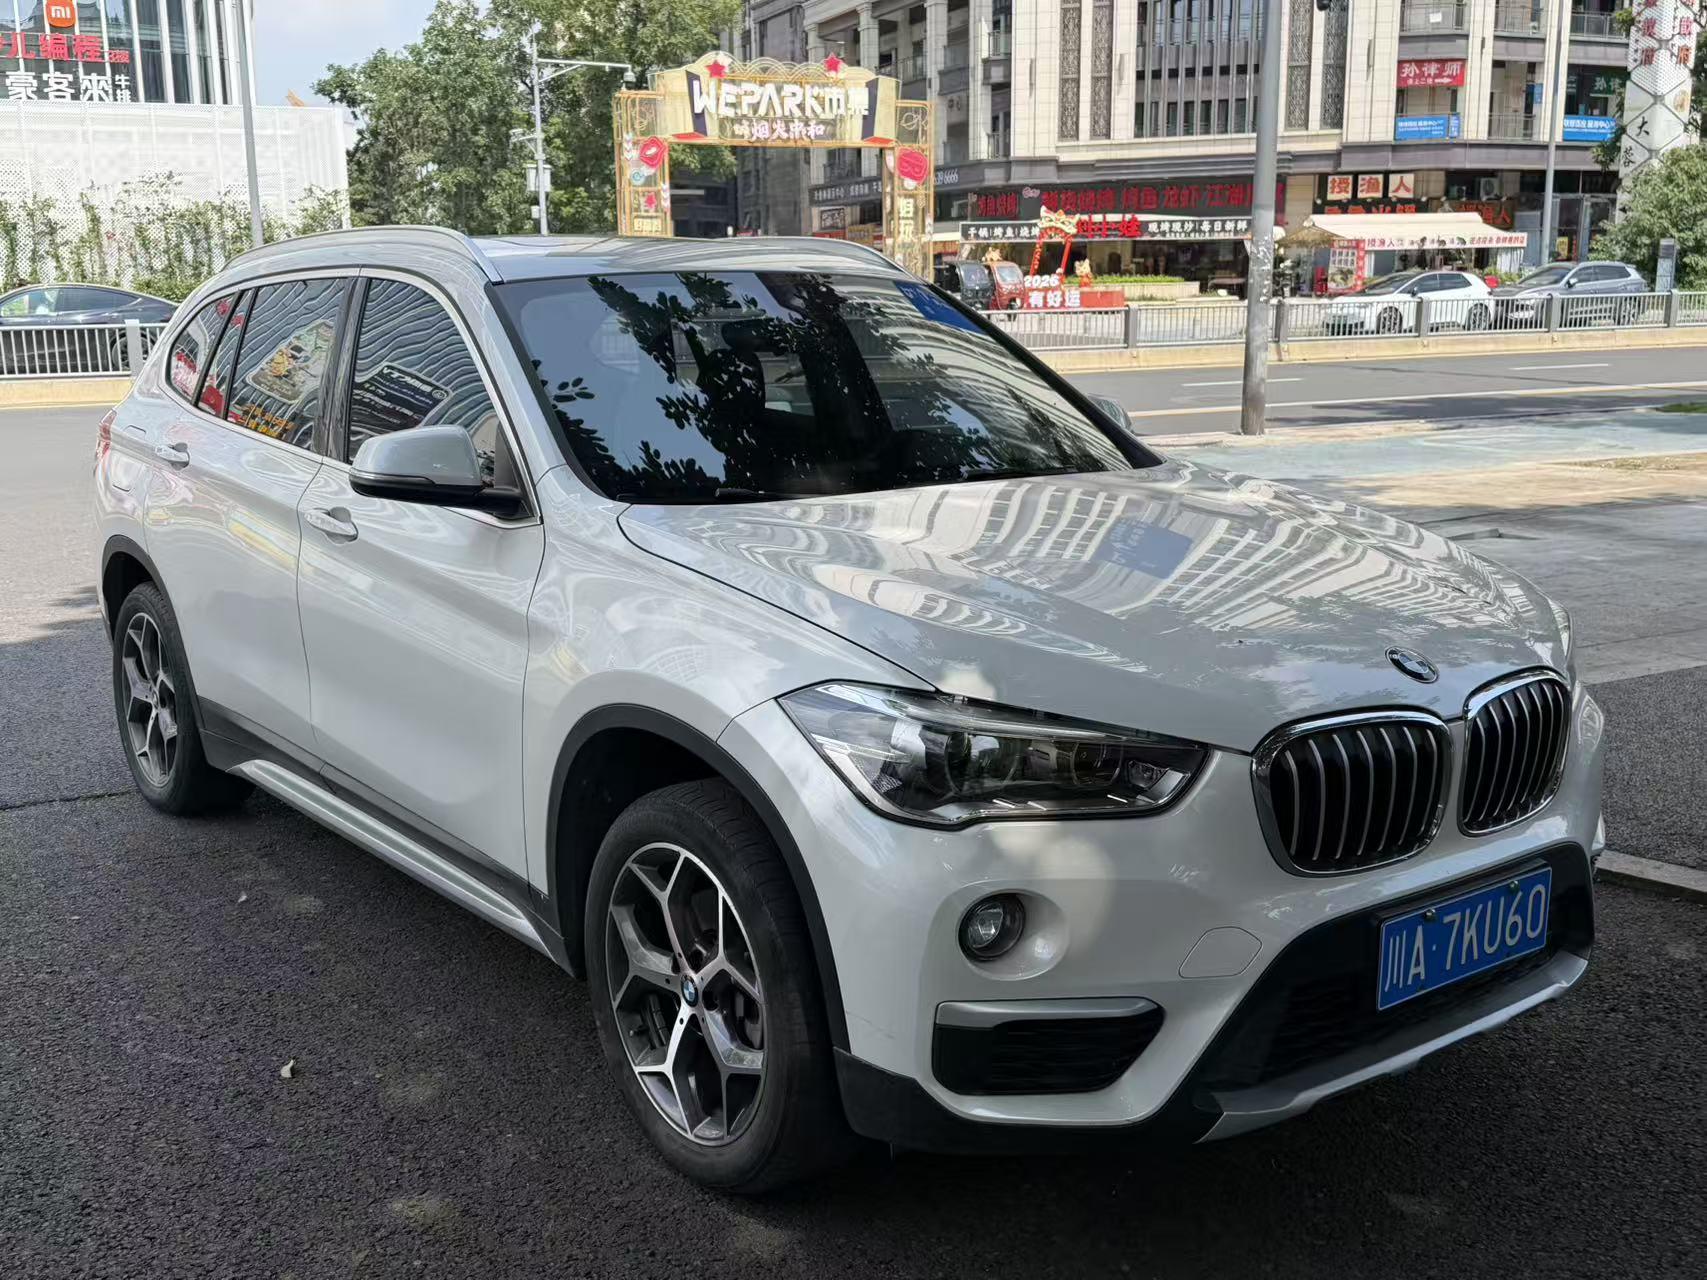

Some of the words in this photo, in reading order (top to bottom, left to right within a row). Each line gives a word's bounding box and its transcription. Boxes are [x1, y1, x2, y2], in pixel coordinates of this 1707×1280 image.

[0, 32, 104, 62] 儿编程
[1400, 61, 1462, 77] 孙律师
[1200, 220, 1248, 232] 每日新鲜
[1024, 274, 1060, 288] 2026
[1028, 290, 1081, 308] 有好运
